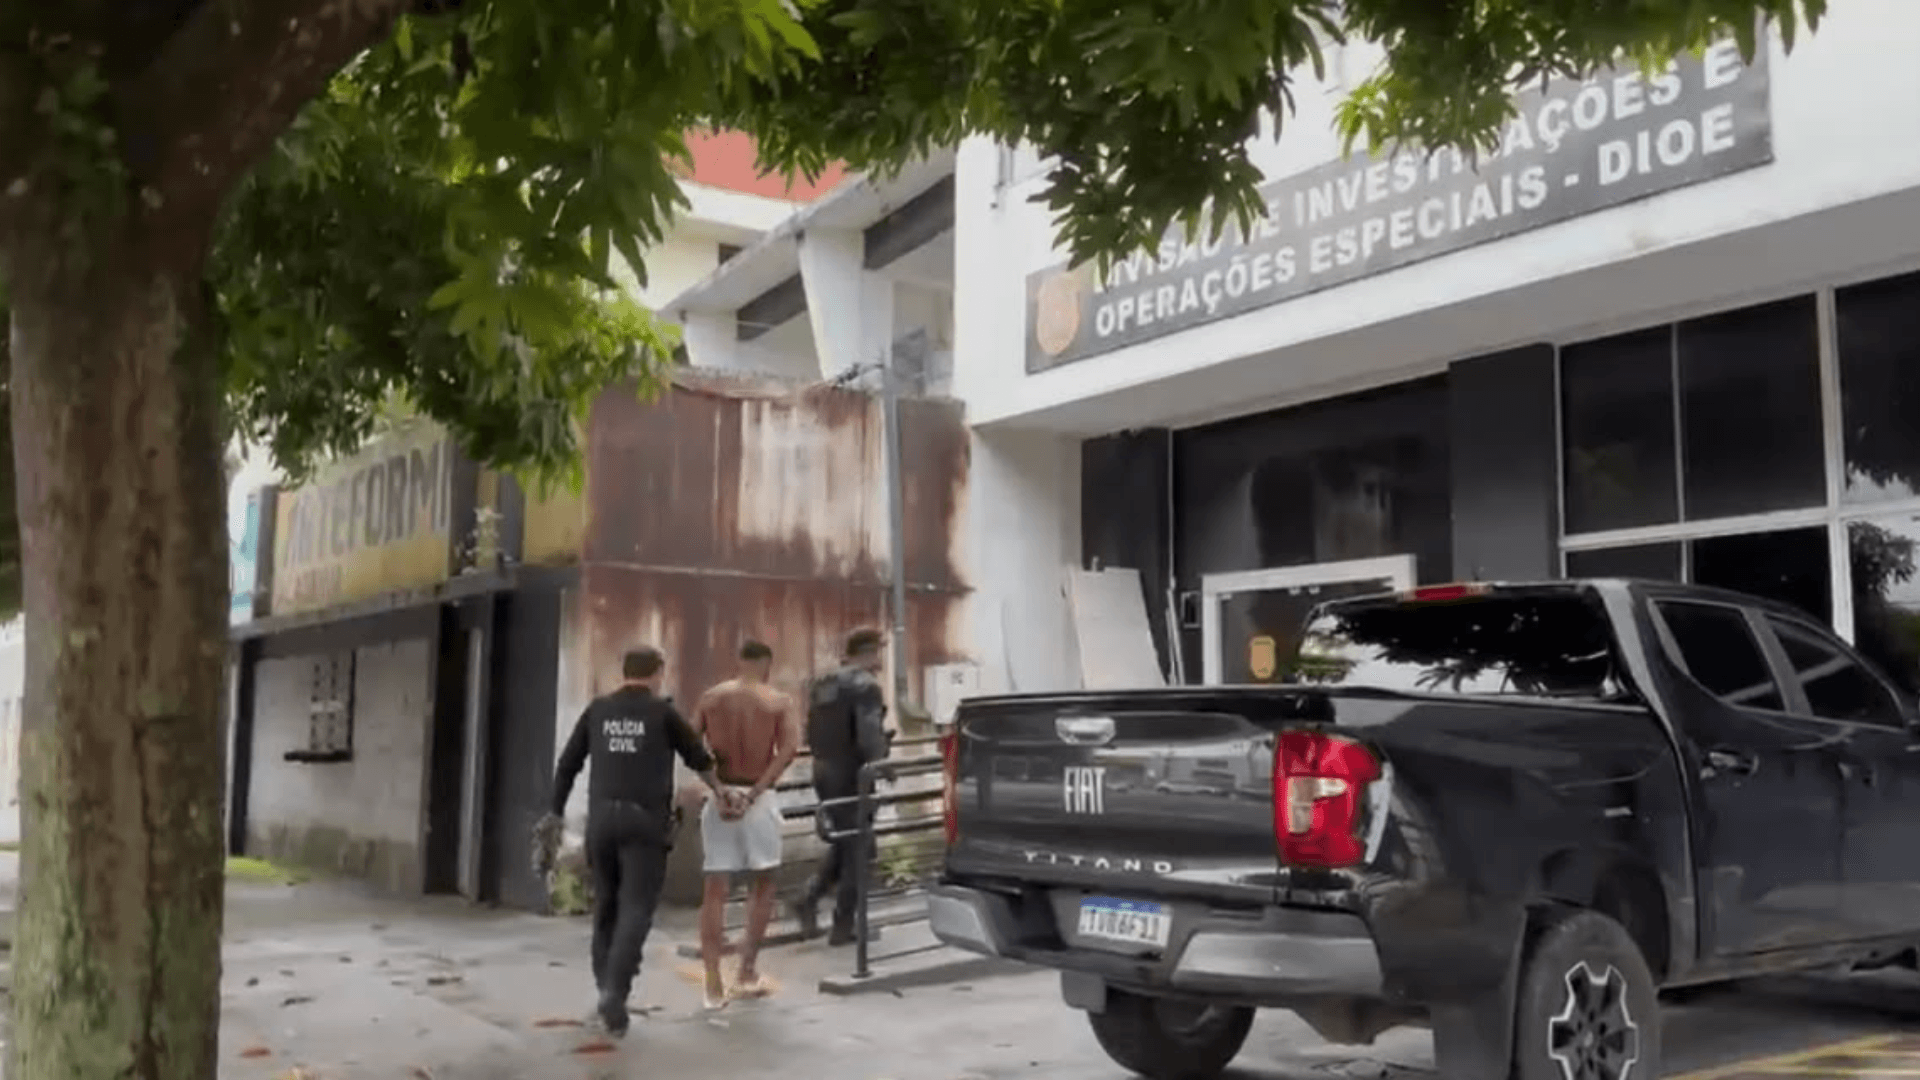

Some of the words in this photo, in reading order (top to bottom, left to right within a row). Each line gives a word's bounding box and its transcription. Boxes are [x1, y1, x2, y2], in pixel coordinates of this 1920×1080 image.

[1295, 60, 1682, 226] INVESTIAÇÕES
[1704, 38, 1741, 90] E
[1096, 246, 1296, 337] OPERAÇÕES
[1310, 166, 1547, 273] ESPECIAIS
[1564, 173, 1580, 187] -
[1599, 103, 1735, 186] DIOE
[602, 717, 645, 737] POLÍCIA
[608, 737, 637, 753] CIVIL
[1064, 766, 1106, 813] FIAT
[1023, 851, 1172, 873] TITANO
